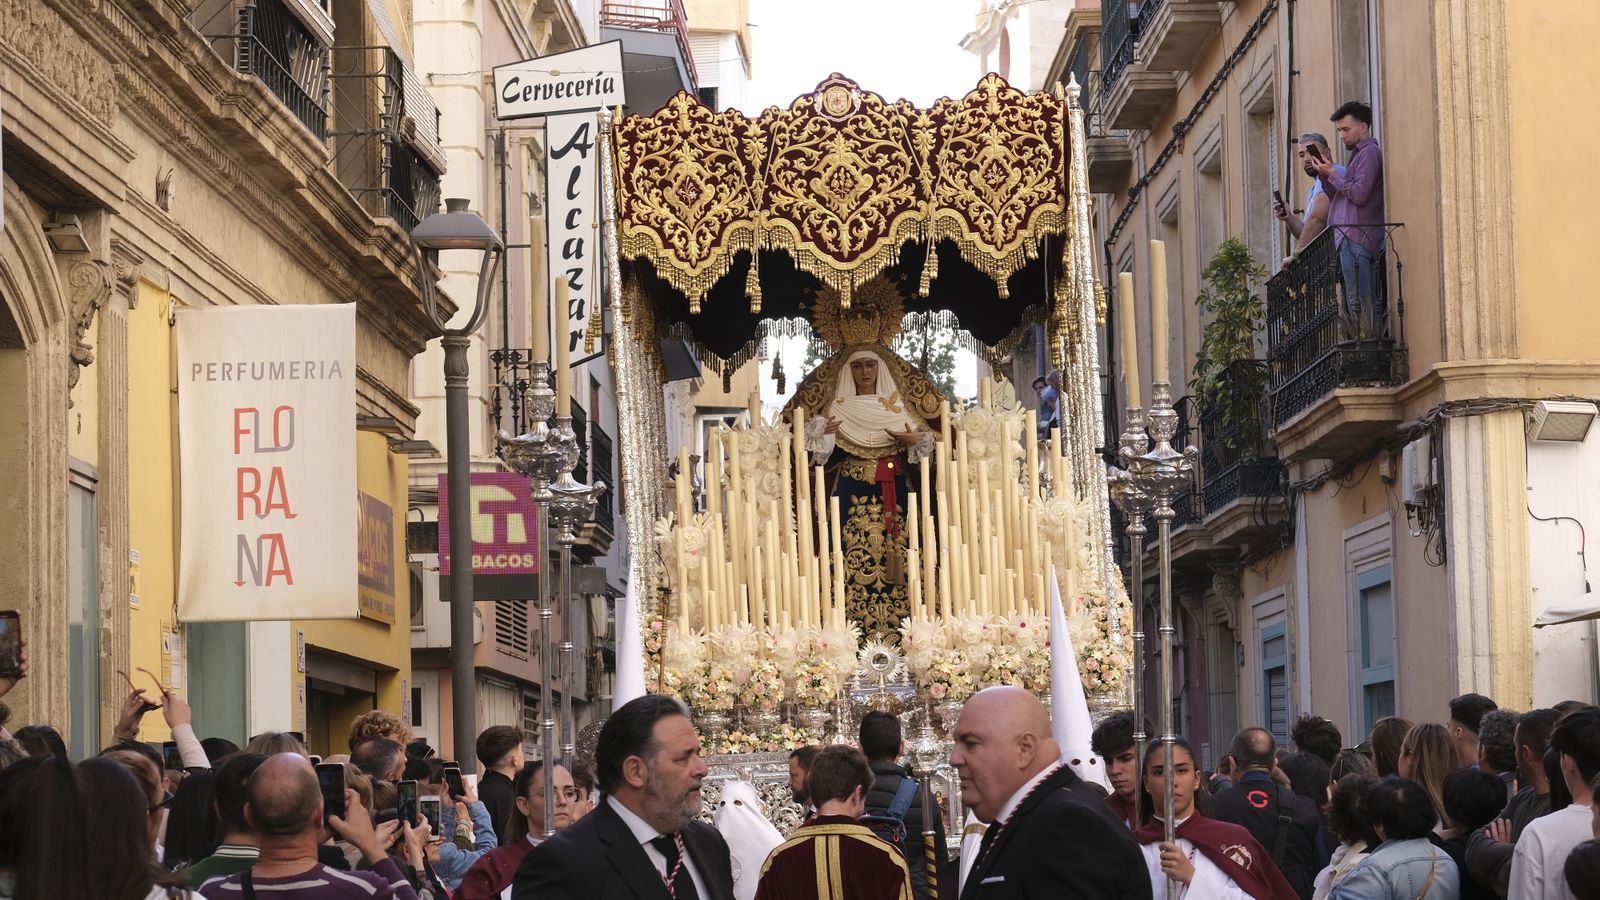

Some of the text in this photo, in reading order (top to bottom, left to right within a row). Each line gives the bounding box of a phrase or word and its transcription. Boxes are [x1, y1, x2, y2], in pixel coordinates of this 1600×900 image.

[501, 72, 615, 104] Cervecería
[550, 121, 595, 353] Alcazar
[191, 360, 344, 382] PERFUMERIA
[233, 405, 296, 455] FLO
[236, 466, 299, 521] RA
[233, 532, 294, 588] NA
[446, 554, 534, 568] BACOS
